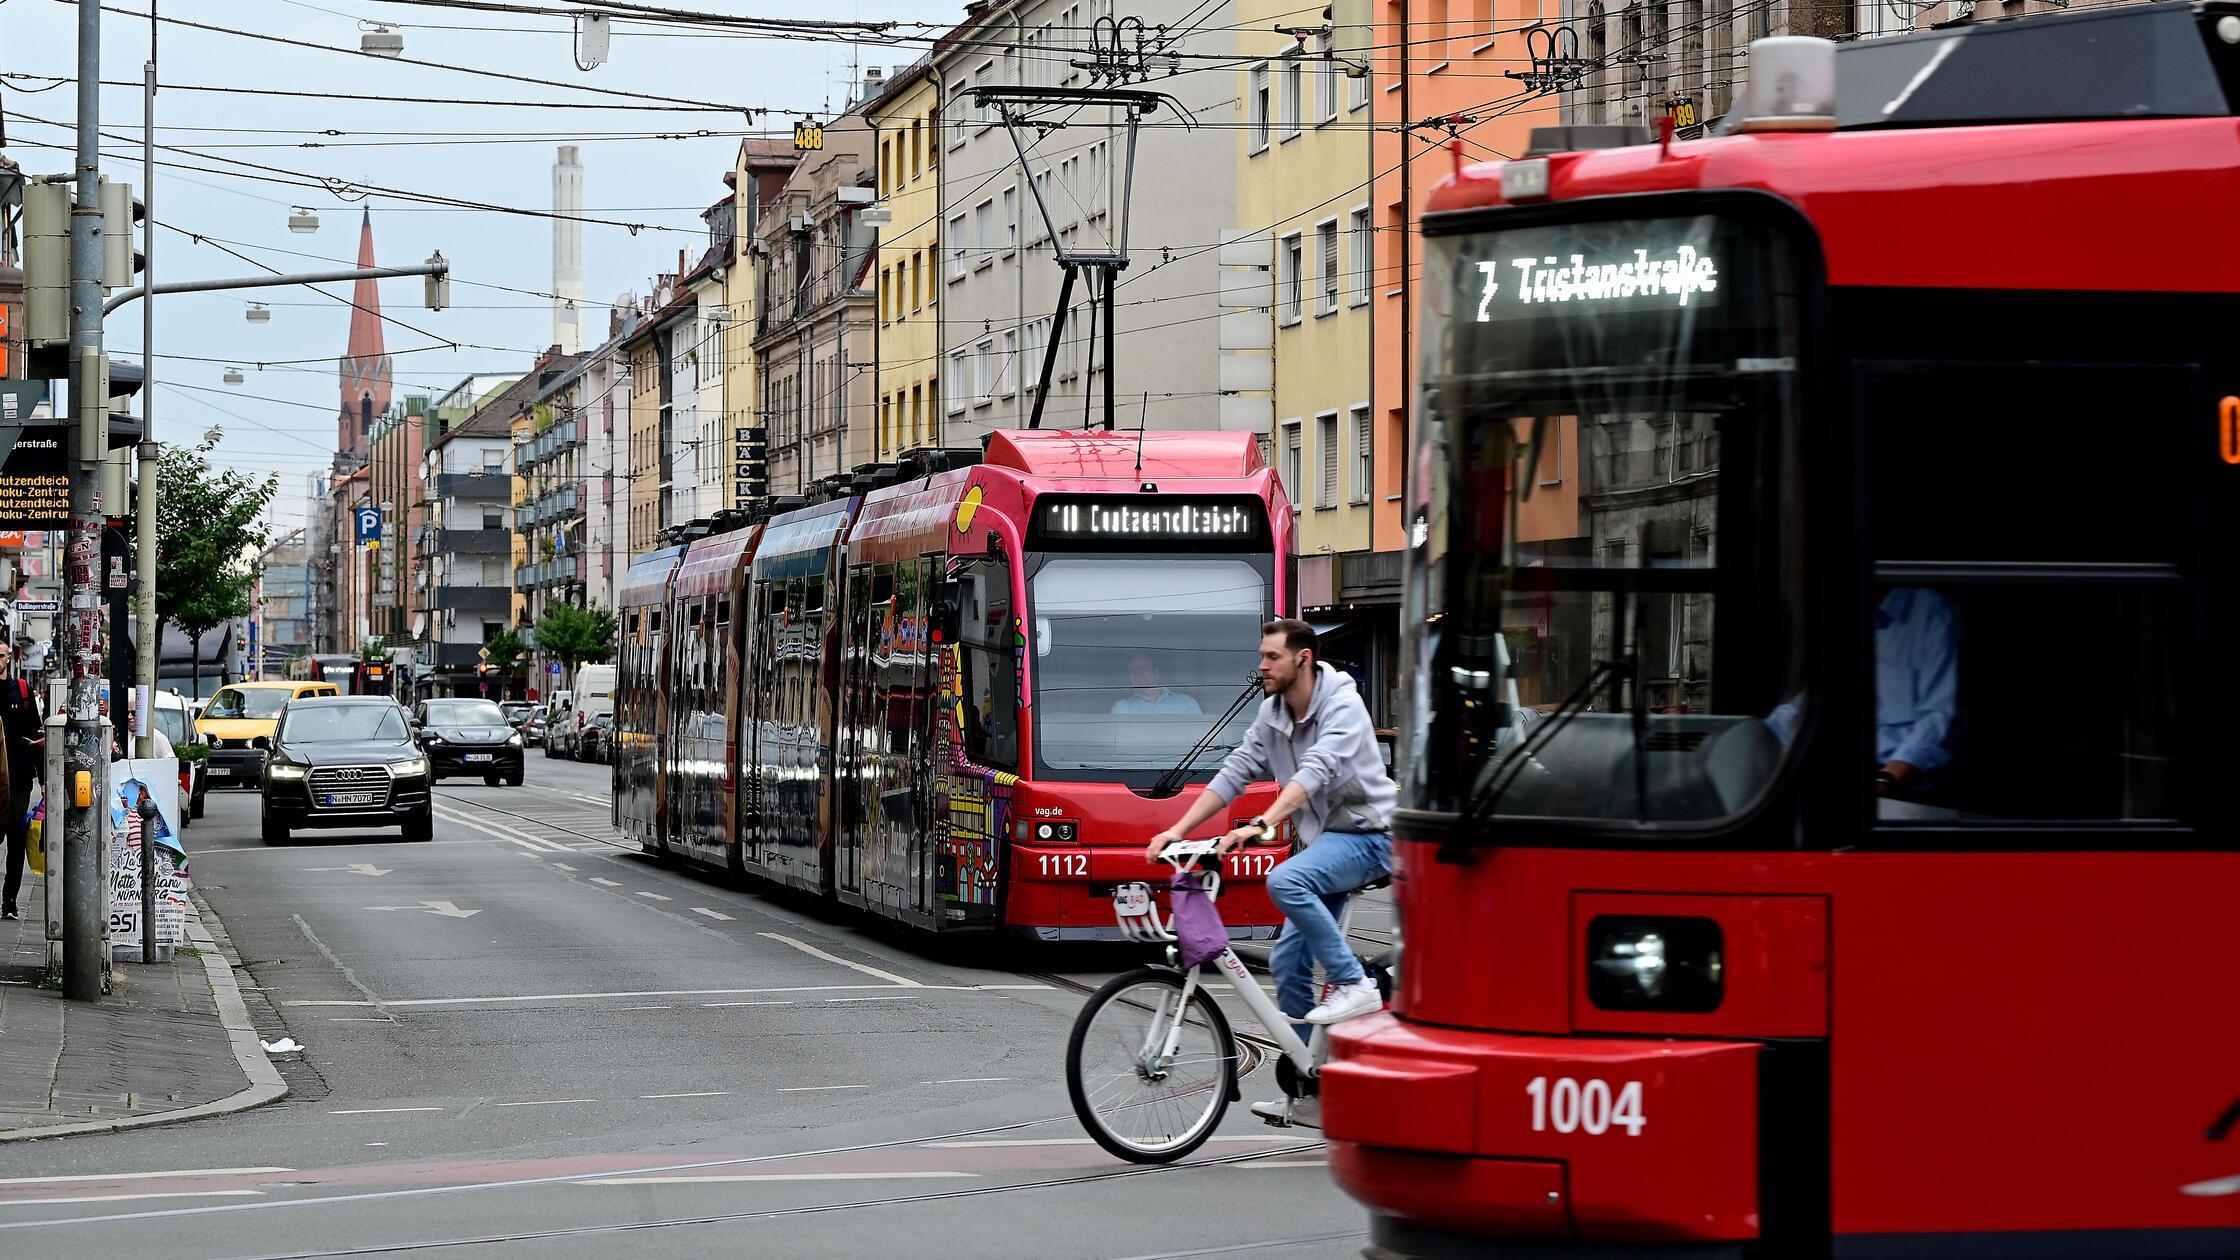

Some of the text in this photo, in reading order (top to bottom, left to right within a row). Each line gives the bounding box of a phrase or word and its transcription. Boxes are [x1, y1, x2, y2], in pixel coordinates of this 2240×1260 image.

[795, 127, 822, 149] 488
[1475, 245, 1718, 322] 7 Tristanstraße
[361, 515, 377, 534] P
[1035, 806, 1063, 818] vag.de
[1039, 855, 1087, 875] 1112
[1230, 855, 1275, 876] 1112
[1526, 1076, 1647, 1137] 1004
